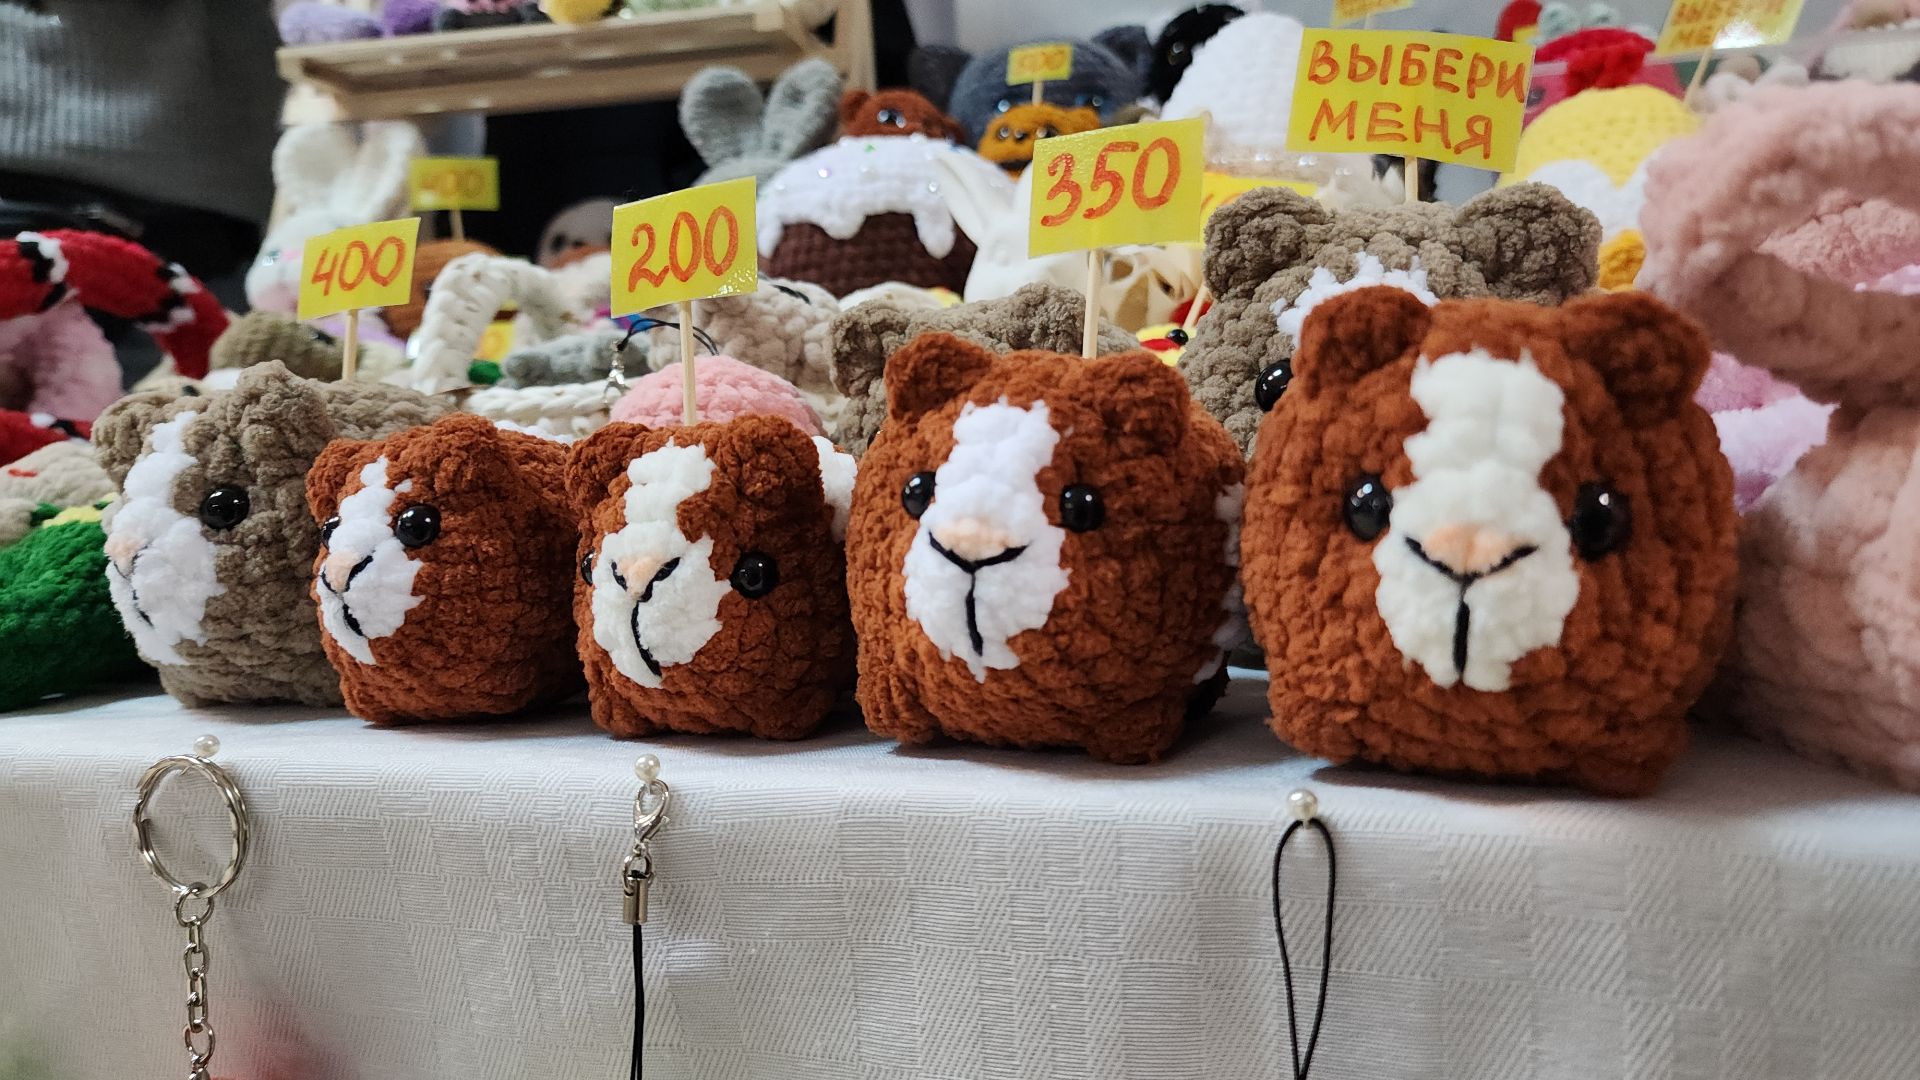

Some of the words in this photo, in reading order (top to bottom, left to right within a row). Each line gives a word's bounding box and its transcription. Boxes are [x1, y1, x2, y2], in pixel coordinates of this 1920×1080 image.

[1307, 39, 1527, 104] ВЫБЕРИ
[1309, 99, 1493, 161] МЕНЯ
[1040, 137, 1181, 227] 350
[313, 236, 405, 295] 400
[628, 206, 740, 292] 200
